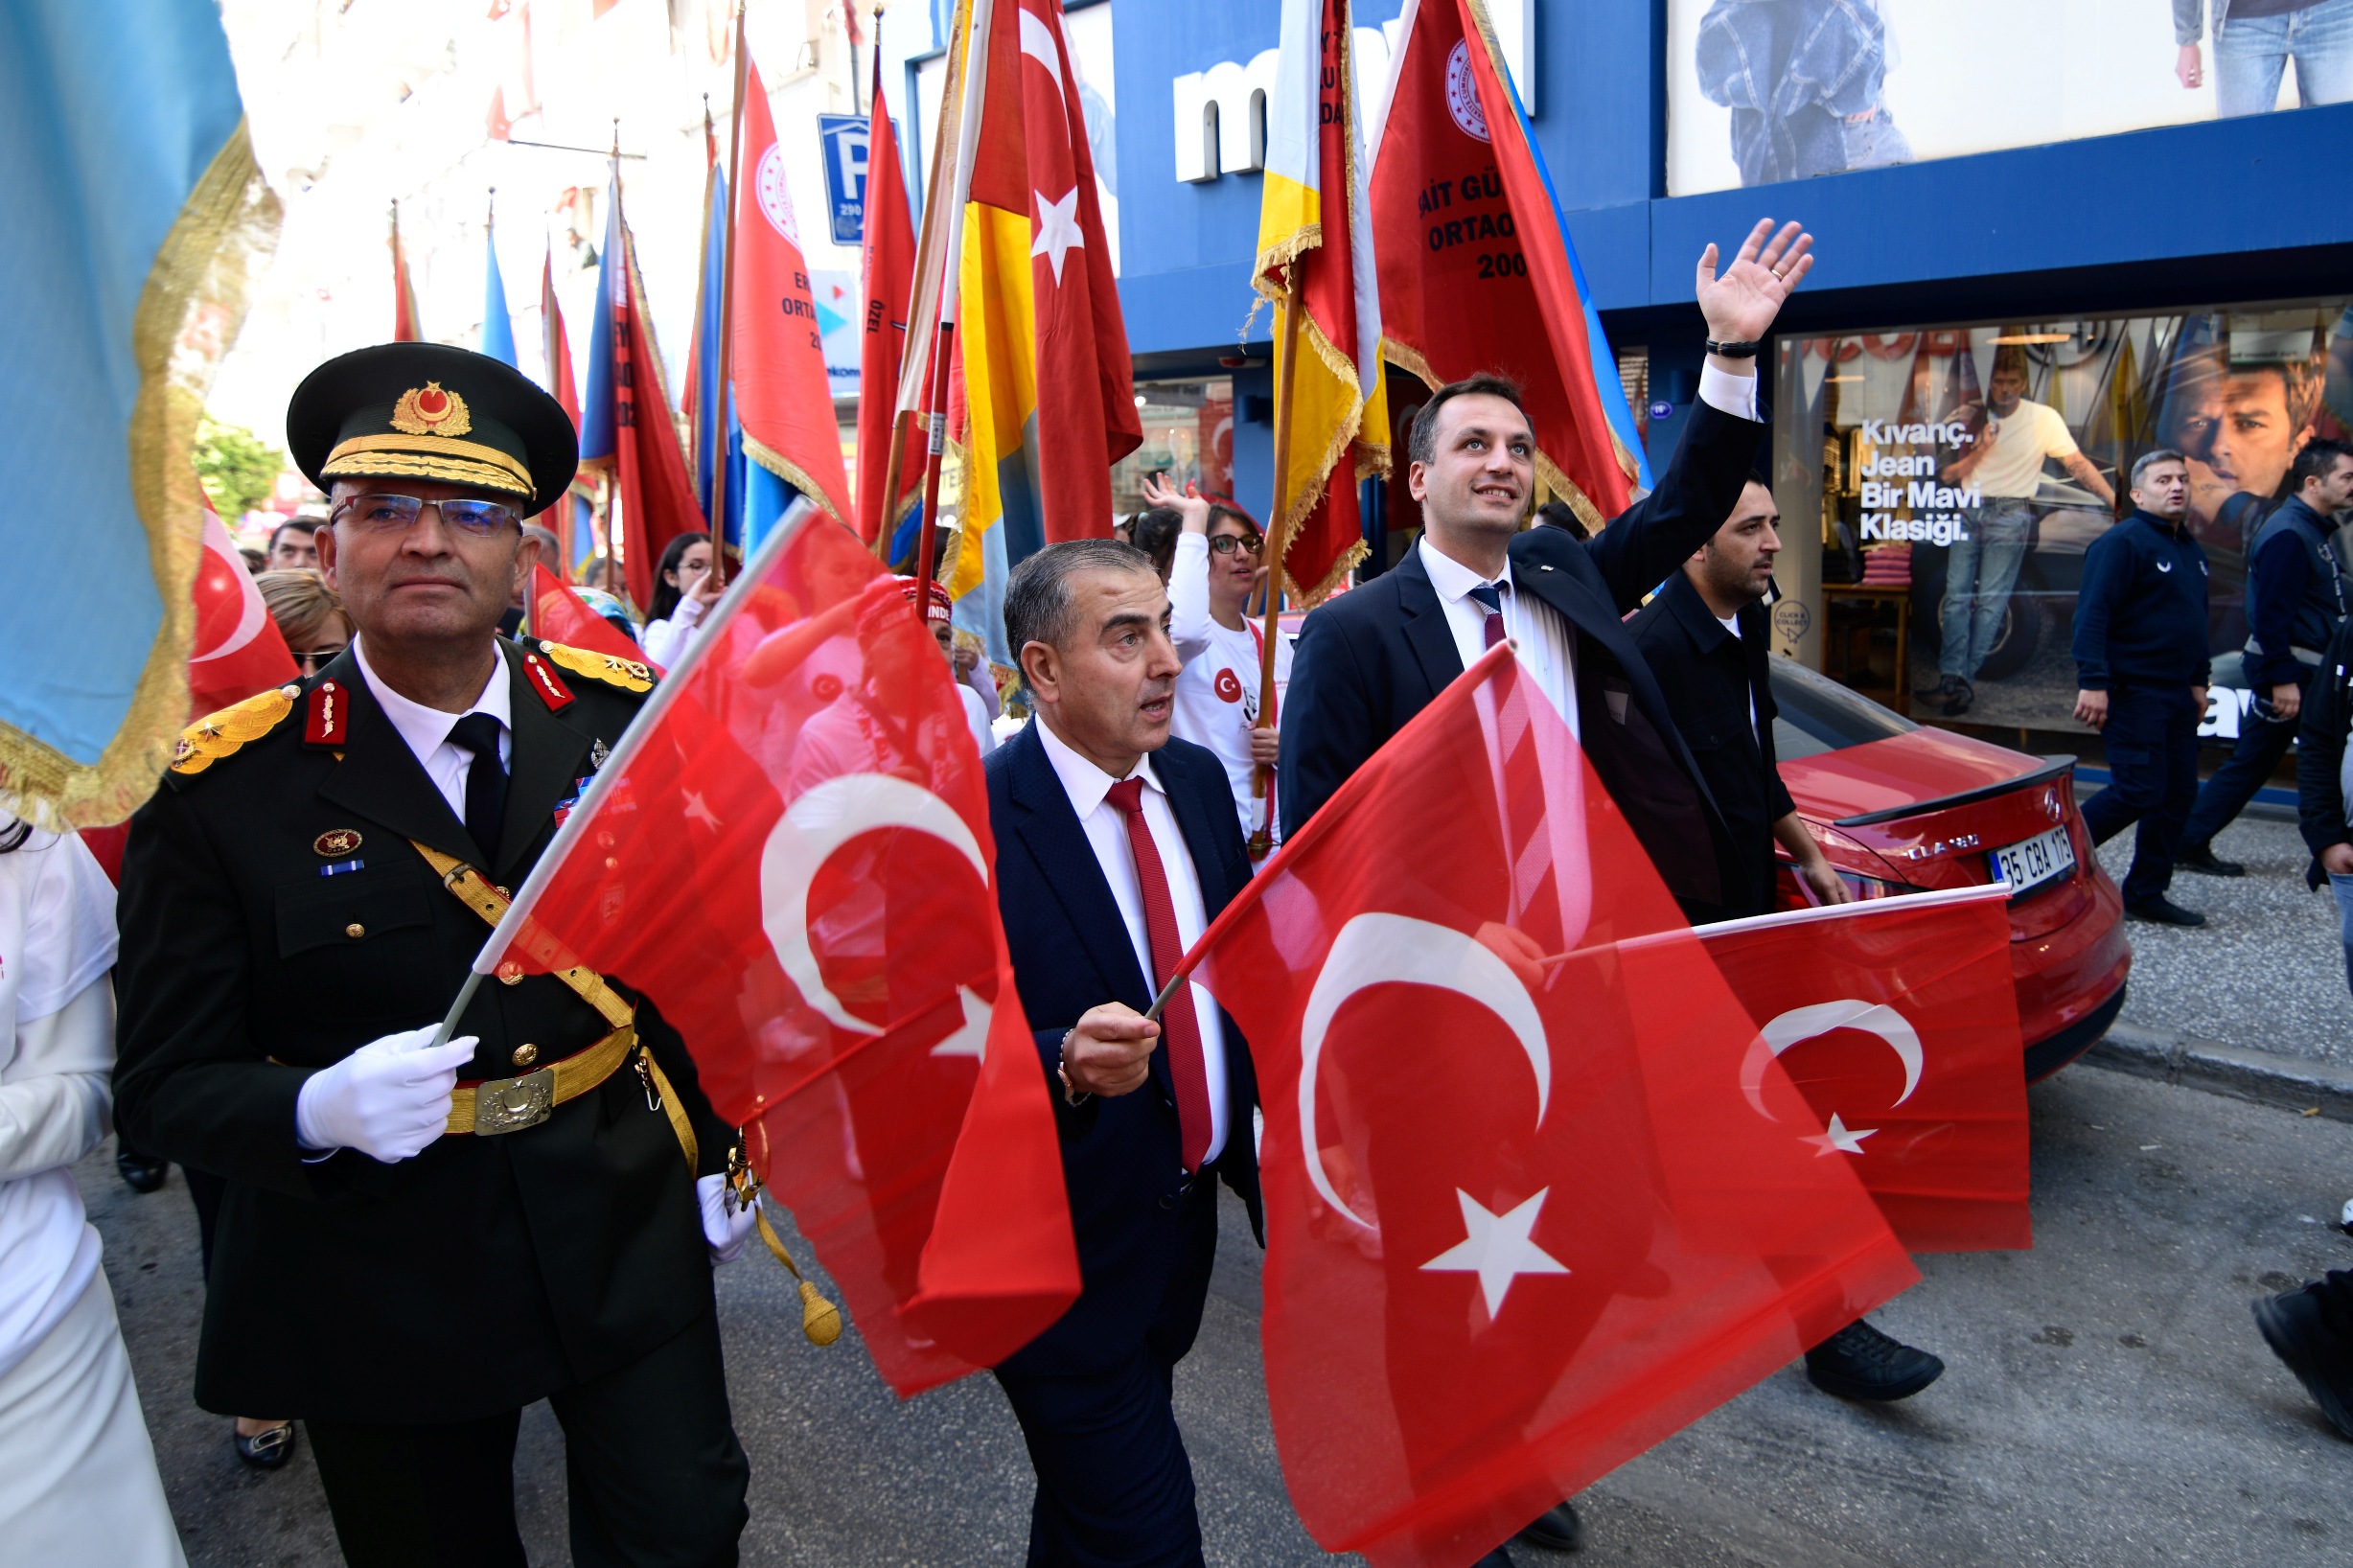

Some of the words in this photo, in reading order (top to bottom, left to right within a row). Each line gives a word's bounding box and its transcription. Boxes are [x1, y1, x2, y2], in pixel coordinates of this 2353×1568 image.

[837, 130, 870, 200] P
[866, 299, 887, 334] ÖZEL
[1862, 418, 1973, 450] Kıvanç.
[1860, 450, 1936, 477] Jean
[1860, 481, 1903, 509] Bir
[1907, 481, 1981, 509] Mavi
[1860, 513, 1970, 547] Klasiği.
[1906, 842, 1948, 861] CLA
[2000, 851, 2023, 890] 35
[2025, 839, 2052, 878] CBA
[2051, 828, 2071, 865] 175
